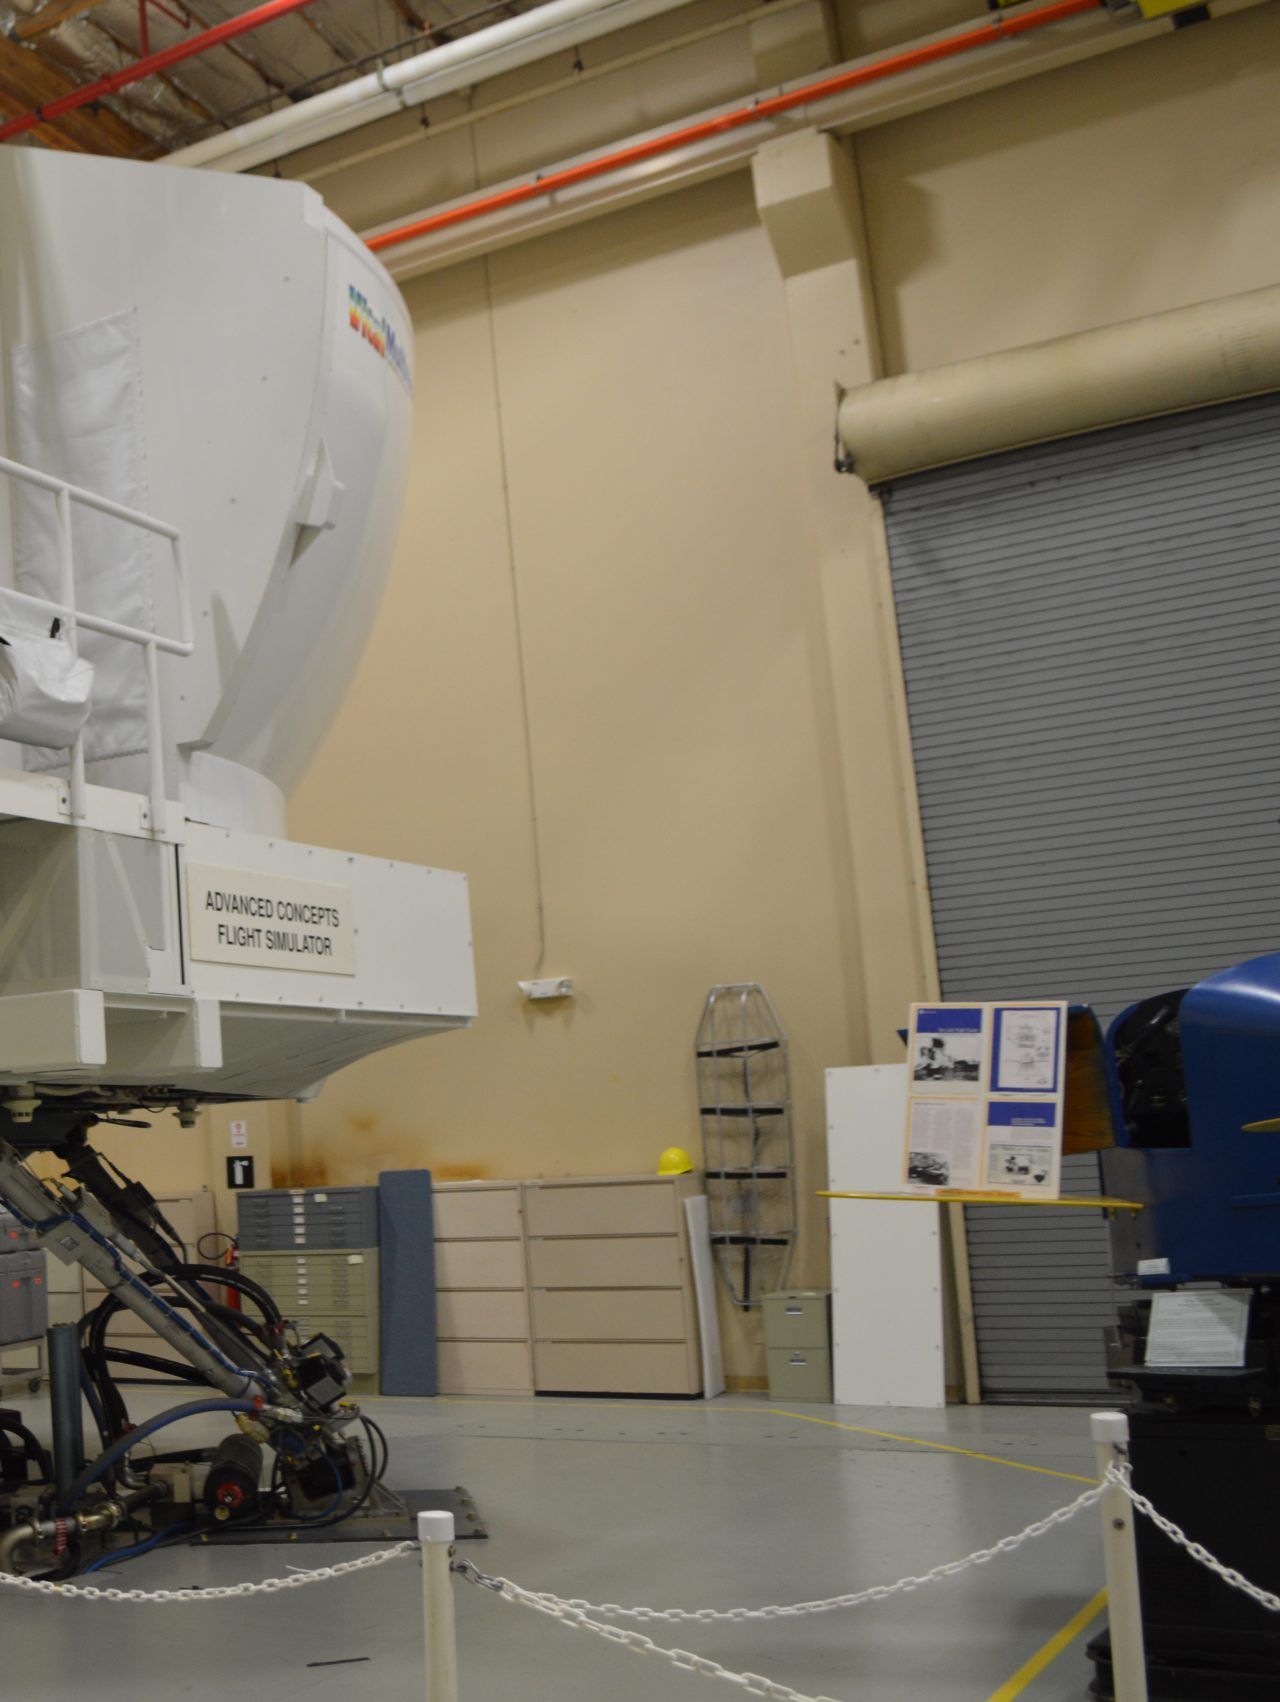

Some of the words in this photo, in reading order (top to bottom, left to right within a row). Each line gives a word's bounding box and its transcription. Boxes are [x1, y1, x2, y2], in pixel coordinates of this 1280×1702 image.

[205, 890, 274, 919] ADVANCED
[276, 900, 340, 928] CONCEPTS
[218, 924, 262, 948] FLIGHT
[265, 930, 333, 956] SIMULATOR
